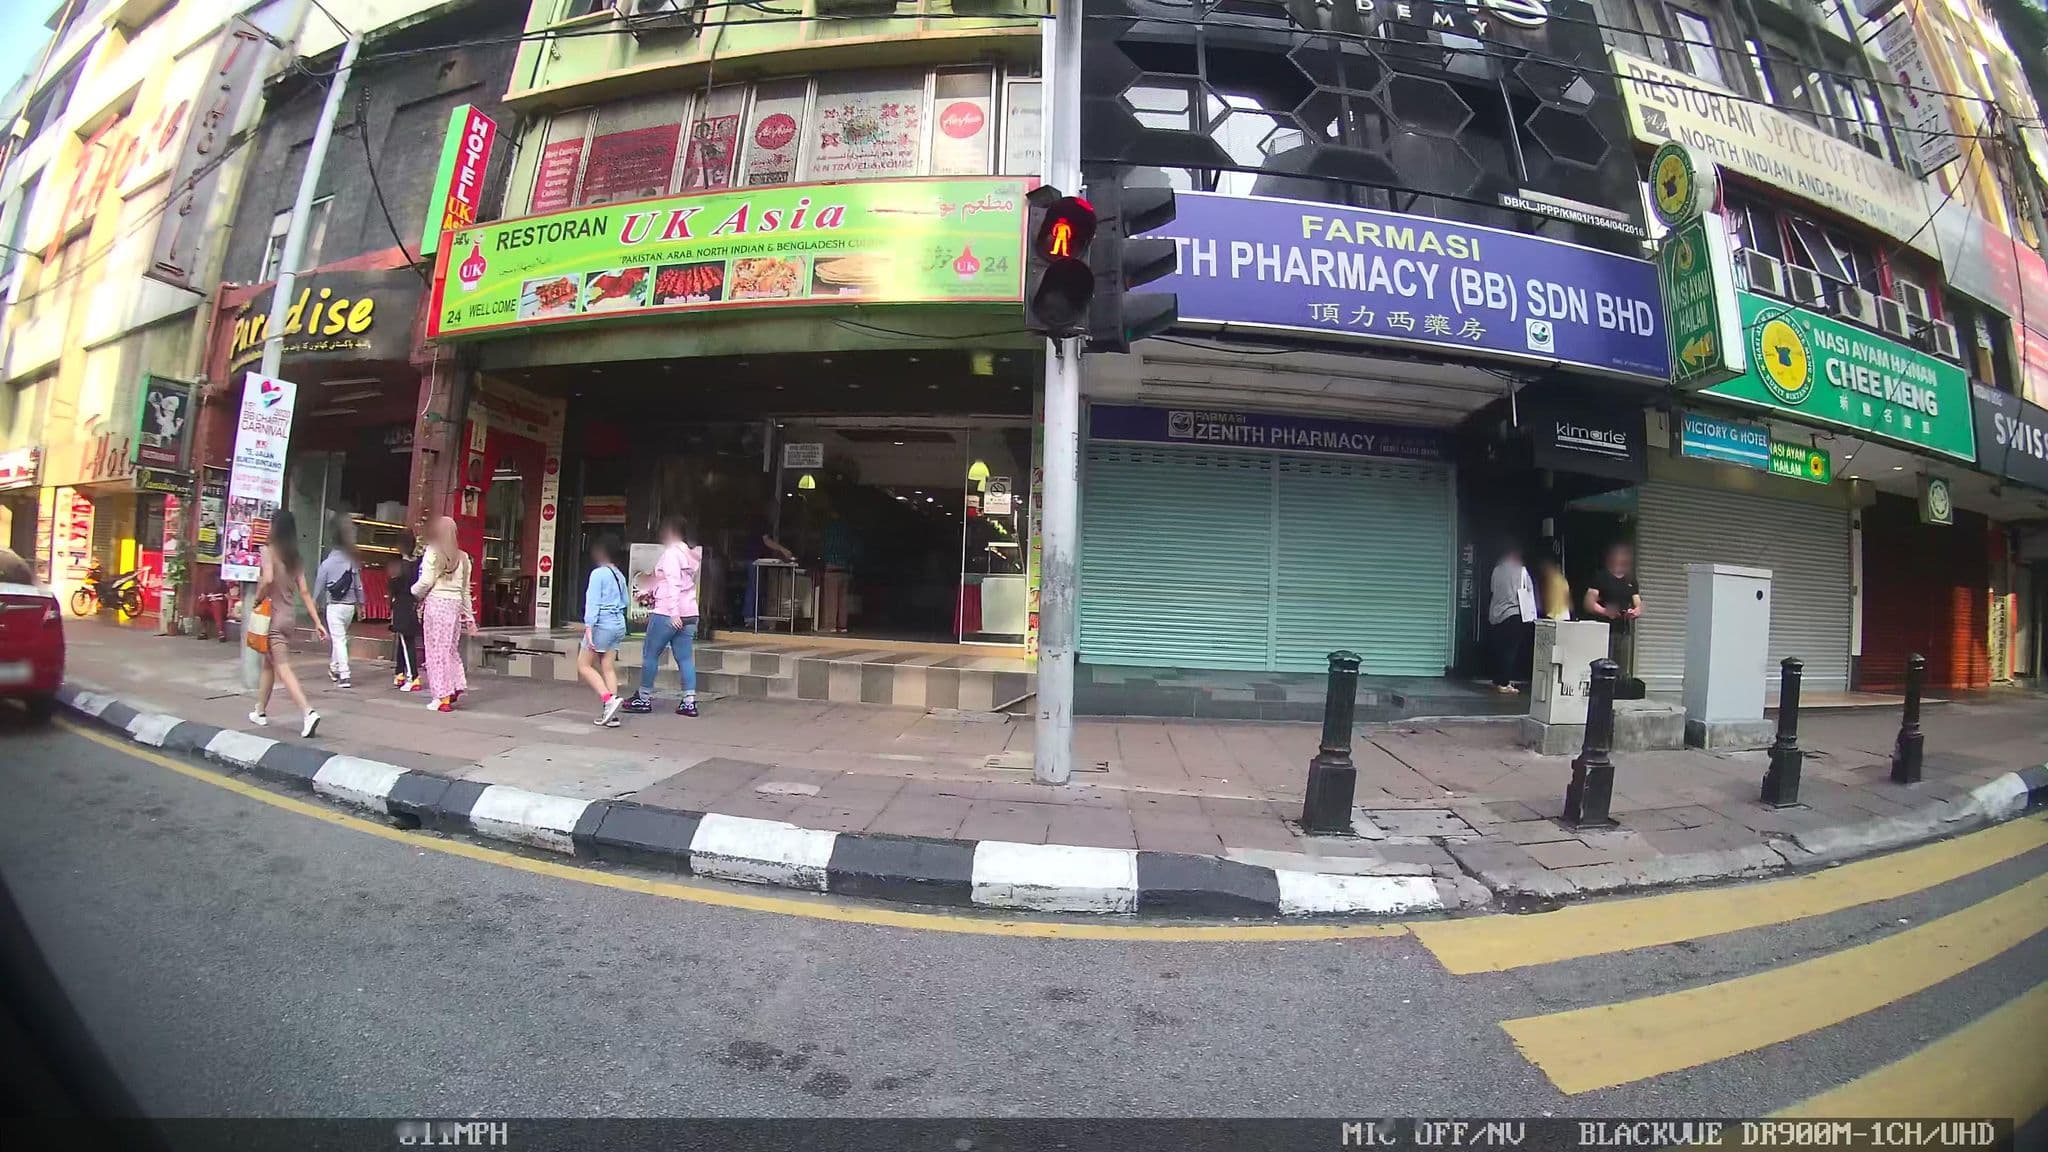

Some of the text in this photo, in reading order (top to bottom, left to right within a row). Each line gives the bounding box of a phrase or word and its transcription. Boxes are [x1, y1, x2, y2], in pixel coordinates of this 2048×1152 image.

[1627, 63, 1758, 137] RESTORAN
[457, 115, 489, 204] HOTEL
[1679, 128, 1739, 167] NORTH
[1741, 147, 1796, 186] INDIAN
[1797, 173, 1826, 197] AND
[448, 197, 474, 224] UK
[620, 198, 847, 246] UK Asia
[496, 215, 608, 253] RESTORAN
[696, 246, 728, 258] NORTH
[730, 242, 765, 254] INDIAN
[776, 239, 846, 252] BENGLADESH
[1302, 214, 1481, 262] FARMASI
[462, 263, 484, 278] UK
[984, 256, 1009, 273] 24
[1232, 240, 1439, 303] PHARMACY
[1449, 264, 1517, 322] (BB)
[1527, 283, 1589, 326] SDN
[1597, 291, 1655, 338] BHD
[447, 299, 517, 325] 24 WELL COME
[1307, 303, 1487, 344] 頂力西藥房
[1679, 300, 1710, 337] HAILAM
[1812, 327, 1849, 355] NASI
[1851, 341, 1889, 368] AYAM
[1825, 357, 1881, 394] CHEE
[1883, 374, 1939, 417] MENG
[241, 420, 289, 439] CARNIVAL
[1196, 422, 1265, 444] ZENITH
[1270, 425, 1376, 452] PHARMACY
[1556, 421, 1626, 444] kimarie
[1685, 419, 1769, 448] VICTORY G HOTEL
[1773, 458, 1802, 476] HAILAM
[1786, 448, 1807, 463] AYAM
